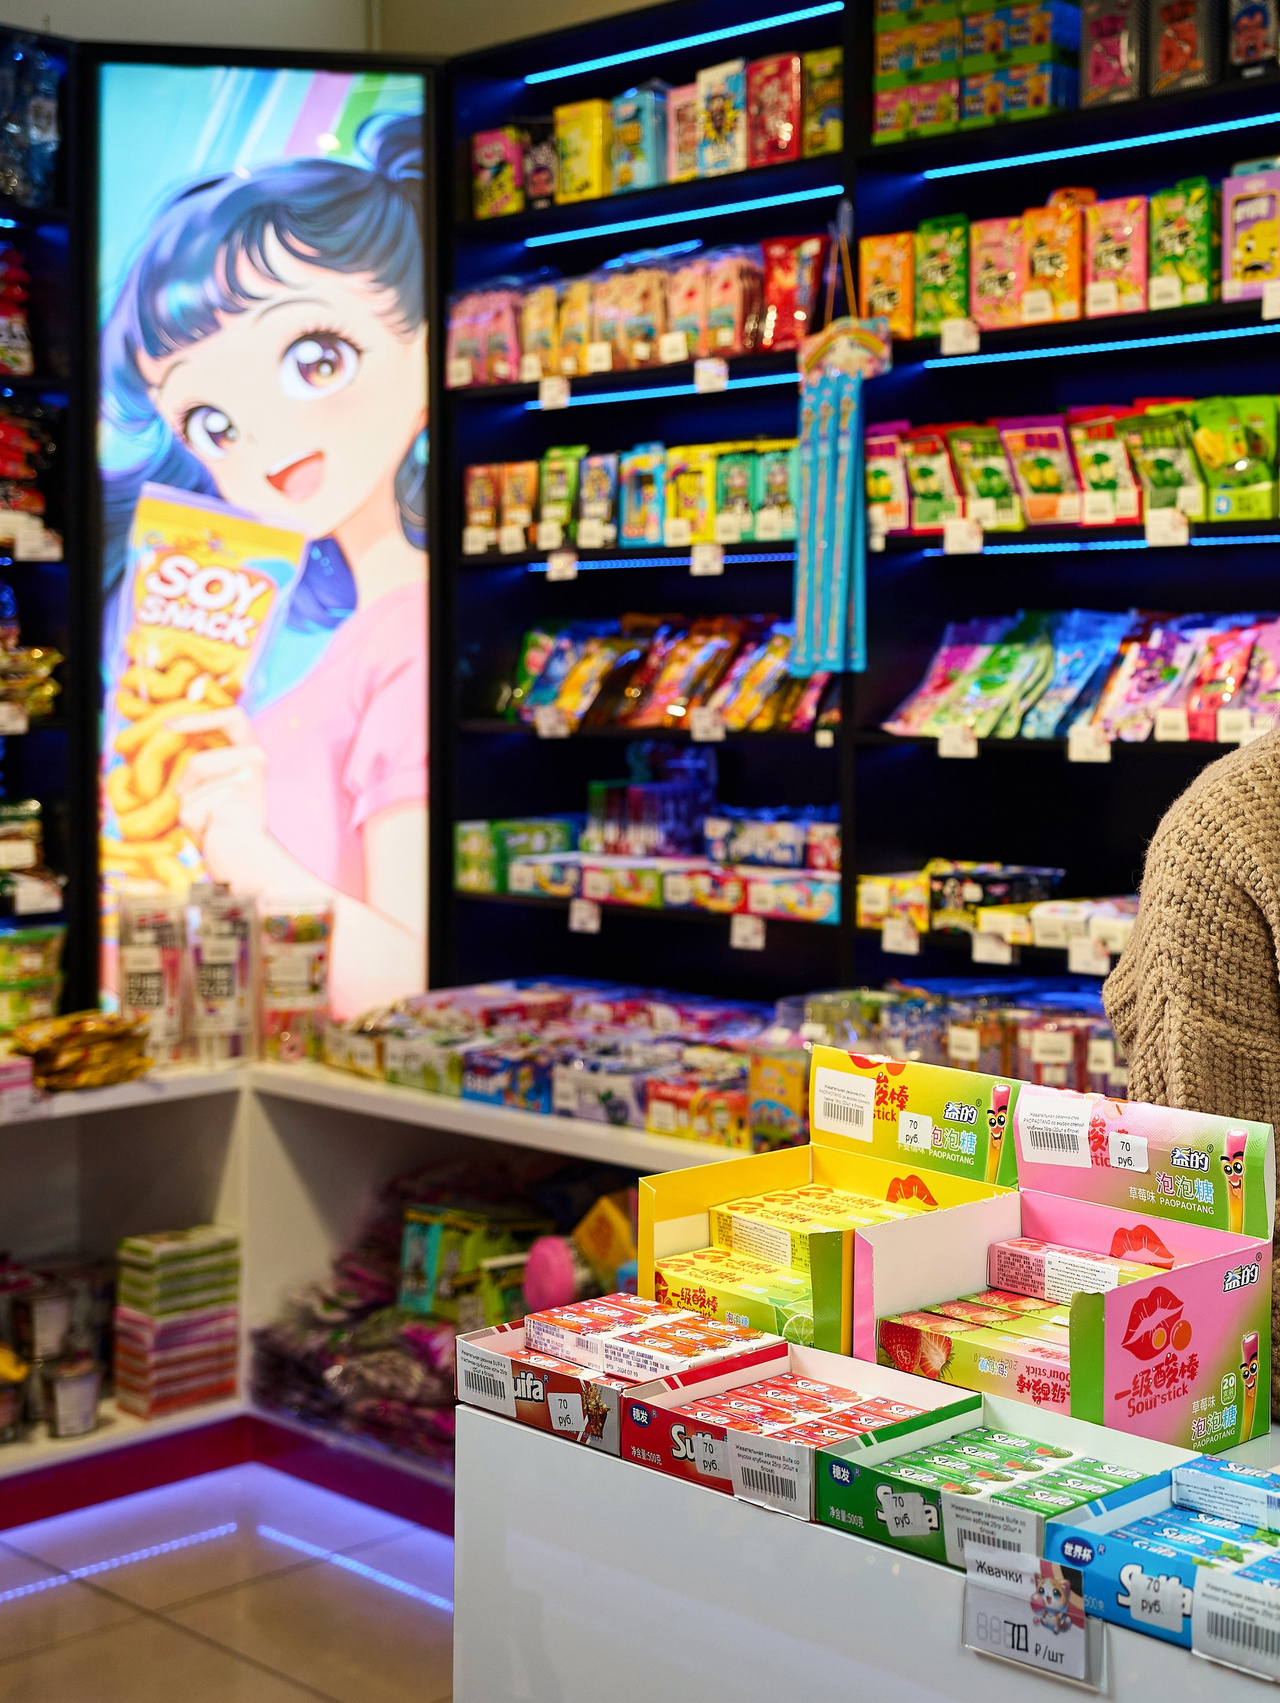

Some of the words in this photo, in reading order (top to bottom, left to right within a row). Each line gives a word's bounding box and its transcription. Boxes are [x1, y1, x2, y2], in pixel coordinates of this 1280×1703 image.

[145, 554, 270, 619] SOY
[138, 594, 257, 648] SNACK
[909, 1120, 918, 1130] 70
[905, 1134, 920, 1145] руб.
[1120, 1140, 1131, 1152] 70
[928, 1148, 975, 1166] PAOPAOTANG
[1117, 1156, 1135, 1168] руб.
[1171, 1147, 1210, 1172] 益的
[1128, 1186, 1157, 1204] 草莓味
[1155, 1171, 1214, 1204] 泡泡糖
[1159, 1197, 1215, 1215] PAOPAOTANG
[671, 1286, 719, 1313] 一级酸棒
[726, 1311, 749, 1327] 泡泡糖
[1114, 1352, 1200, 1400] 一级酸棒
[1223, 1376, 1235, 1390] 20
[512, 1371, 545, 1402] uifa
[558, 1398, 569, 1410] 70
[1192, 1396, 1216, 1414] 草莓味
[558, 1413, 575, 1427] руб.
[1191, 1404, 1238, 1441] 泡泡糖
[703, 1442, 714, 1454] 70
[1192, 1428, 1236, 1450] PAOPAOTANG
[734, 1444, 764, 1456] Жевательная
[765, 1452, 782, 1461] резинка
[702, 1458, 721, 1472] руб.
[893, 1495, 905, 1508] 70
[828, 1505, 865, 1529] 净含量:500克
[894, 1511, 914, 1528] руб.
[1063, 1542, 1093, 1562] 世界杯
[975, 1559, 1023, 1585] Жвачки
[1147, 1577, 1161, 1593] 70
[1141, 1597, 1164, 1614] руб.
[1003, 1620, 1029, 1652] 70
